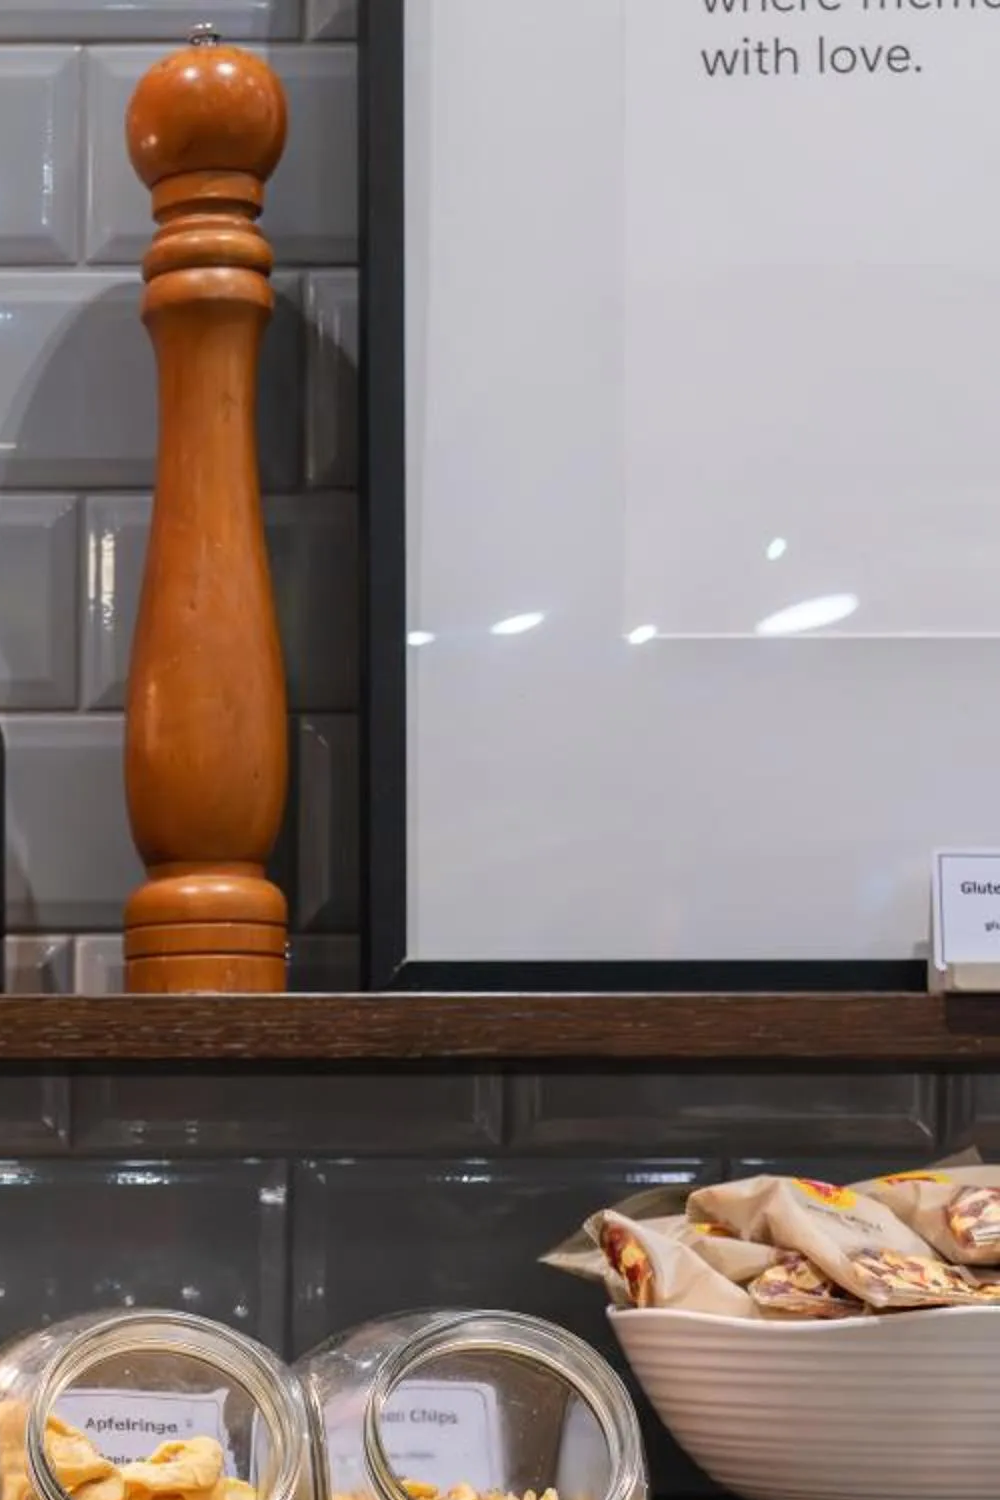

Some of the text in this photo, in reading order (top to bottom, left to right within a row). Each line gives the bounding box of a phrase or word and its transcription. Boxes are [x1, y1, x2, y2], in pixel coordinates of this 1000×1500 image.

[701, 36, 922, 76] with love.
[85, 1417, 178, 1435] Apfelringe
[410, 1410, 459, 1428] Chips
